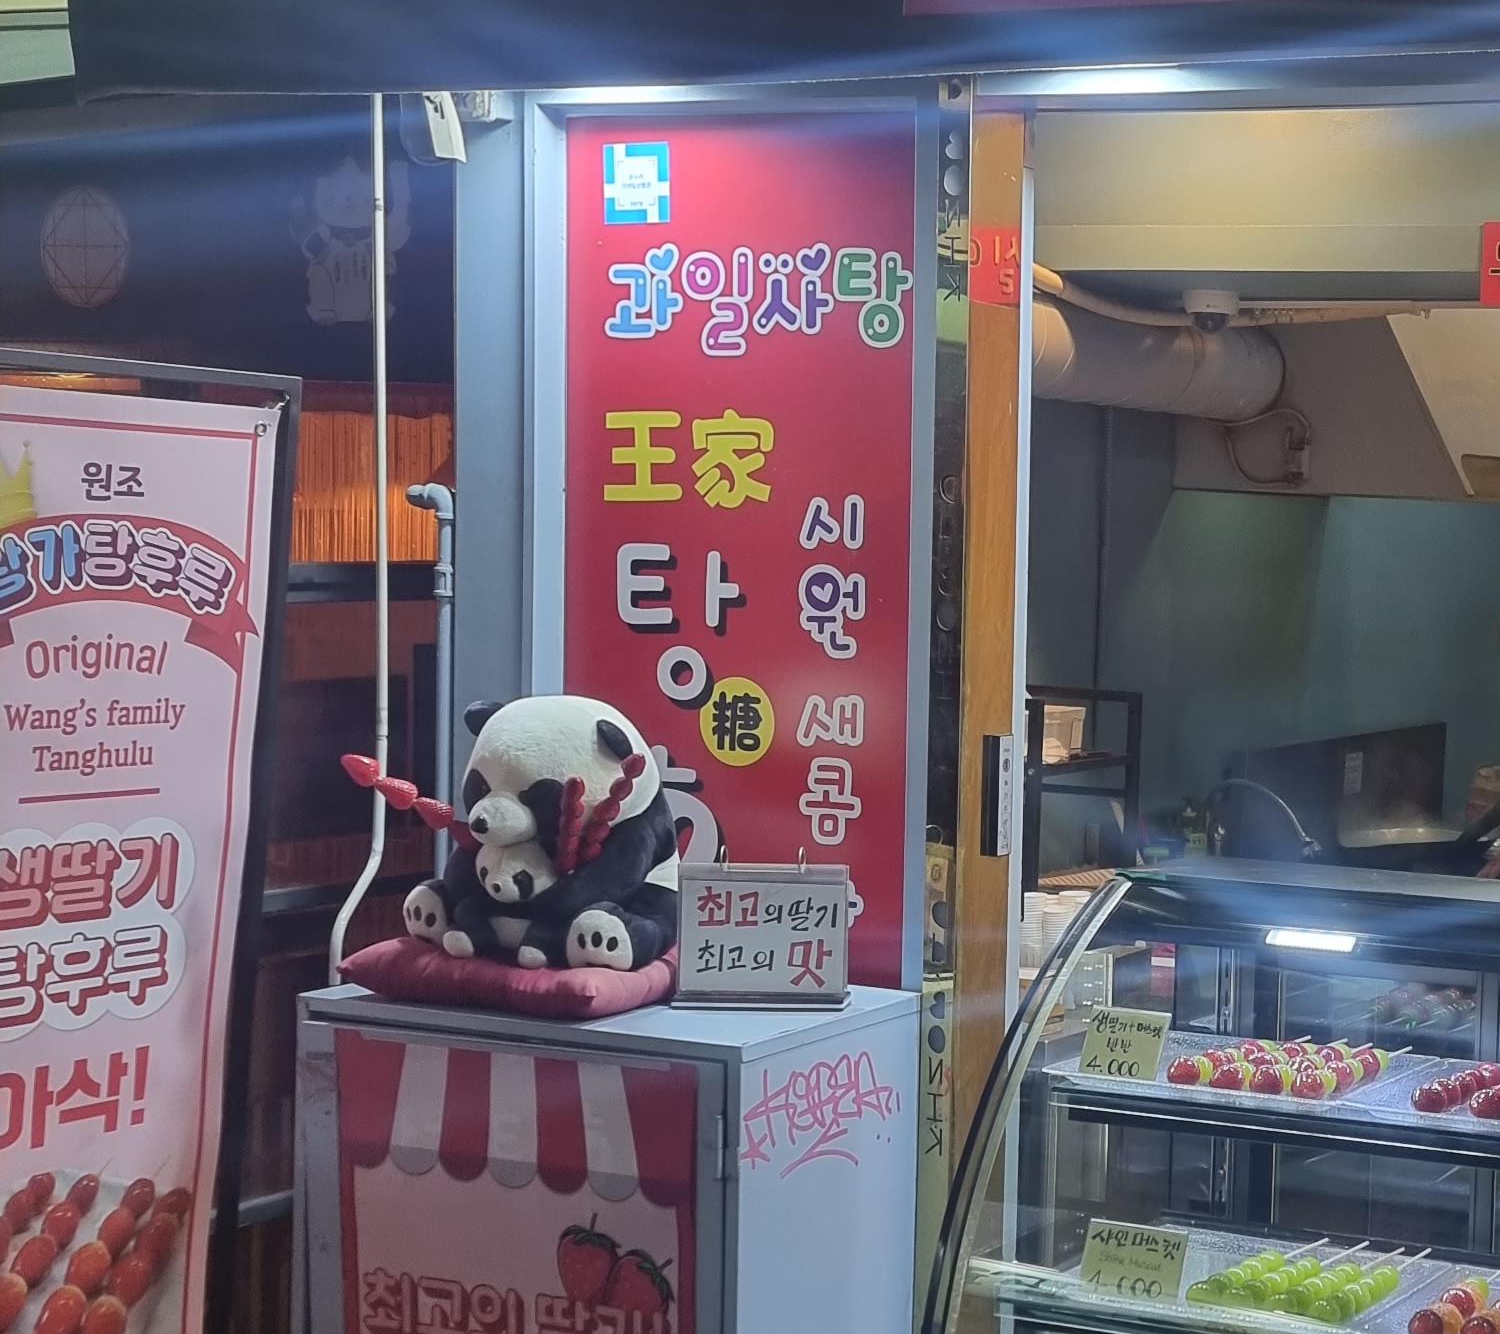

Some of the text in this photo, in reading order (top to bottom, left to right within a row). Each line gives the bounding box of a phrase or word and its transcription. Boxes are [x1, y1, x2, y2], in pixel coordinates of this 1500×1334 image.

[604, 240, 914, 357] 과일사탕
[81, 462, 146, 502] 원조
[604, 408, 775, 511] 王家
[799, 492, 868, 661] 시원
[25, 633, 168, 680] Original
[106, 697, 187, 735] family
[711, 689, 763, 755] 糖
[32, 741, 154, 775] Tanghulu
[795, 691, 867, 847] 새콤
[696, 937, 833, 989] 최고의 맛
